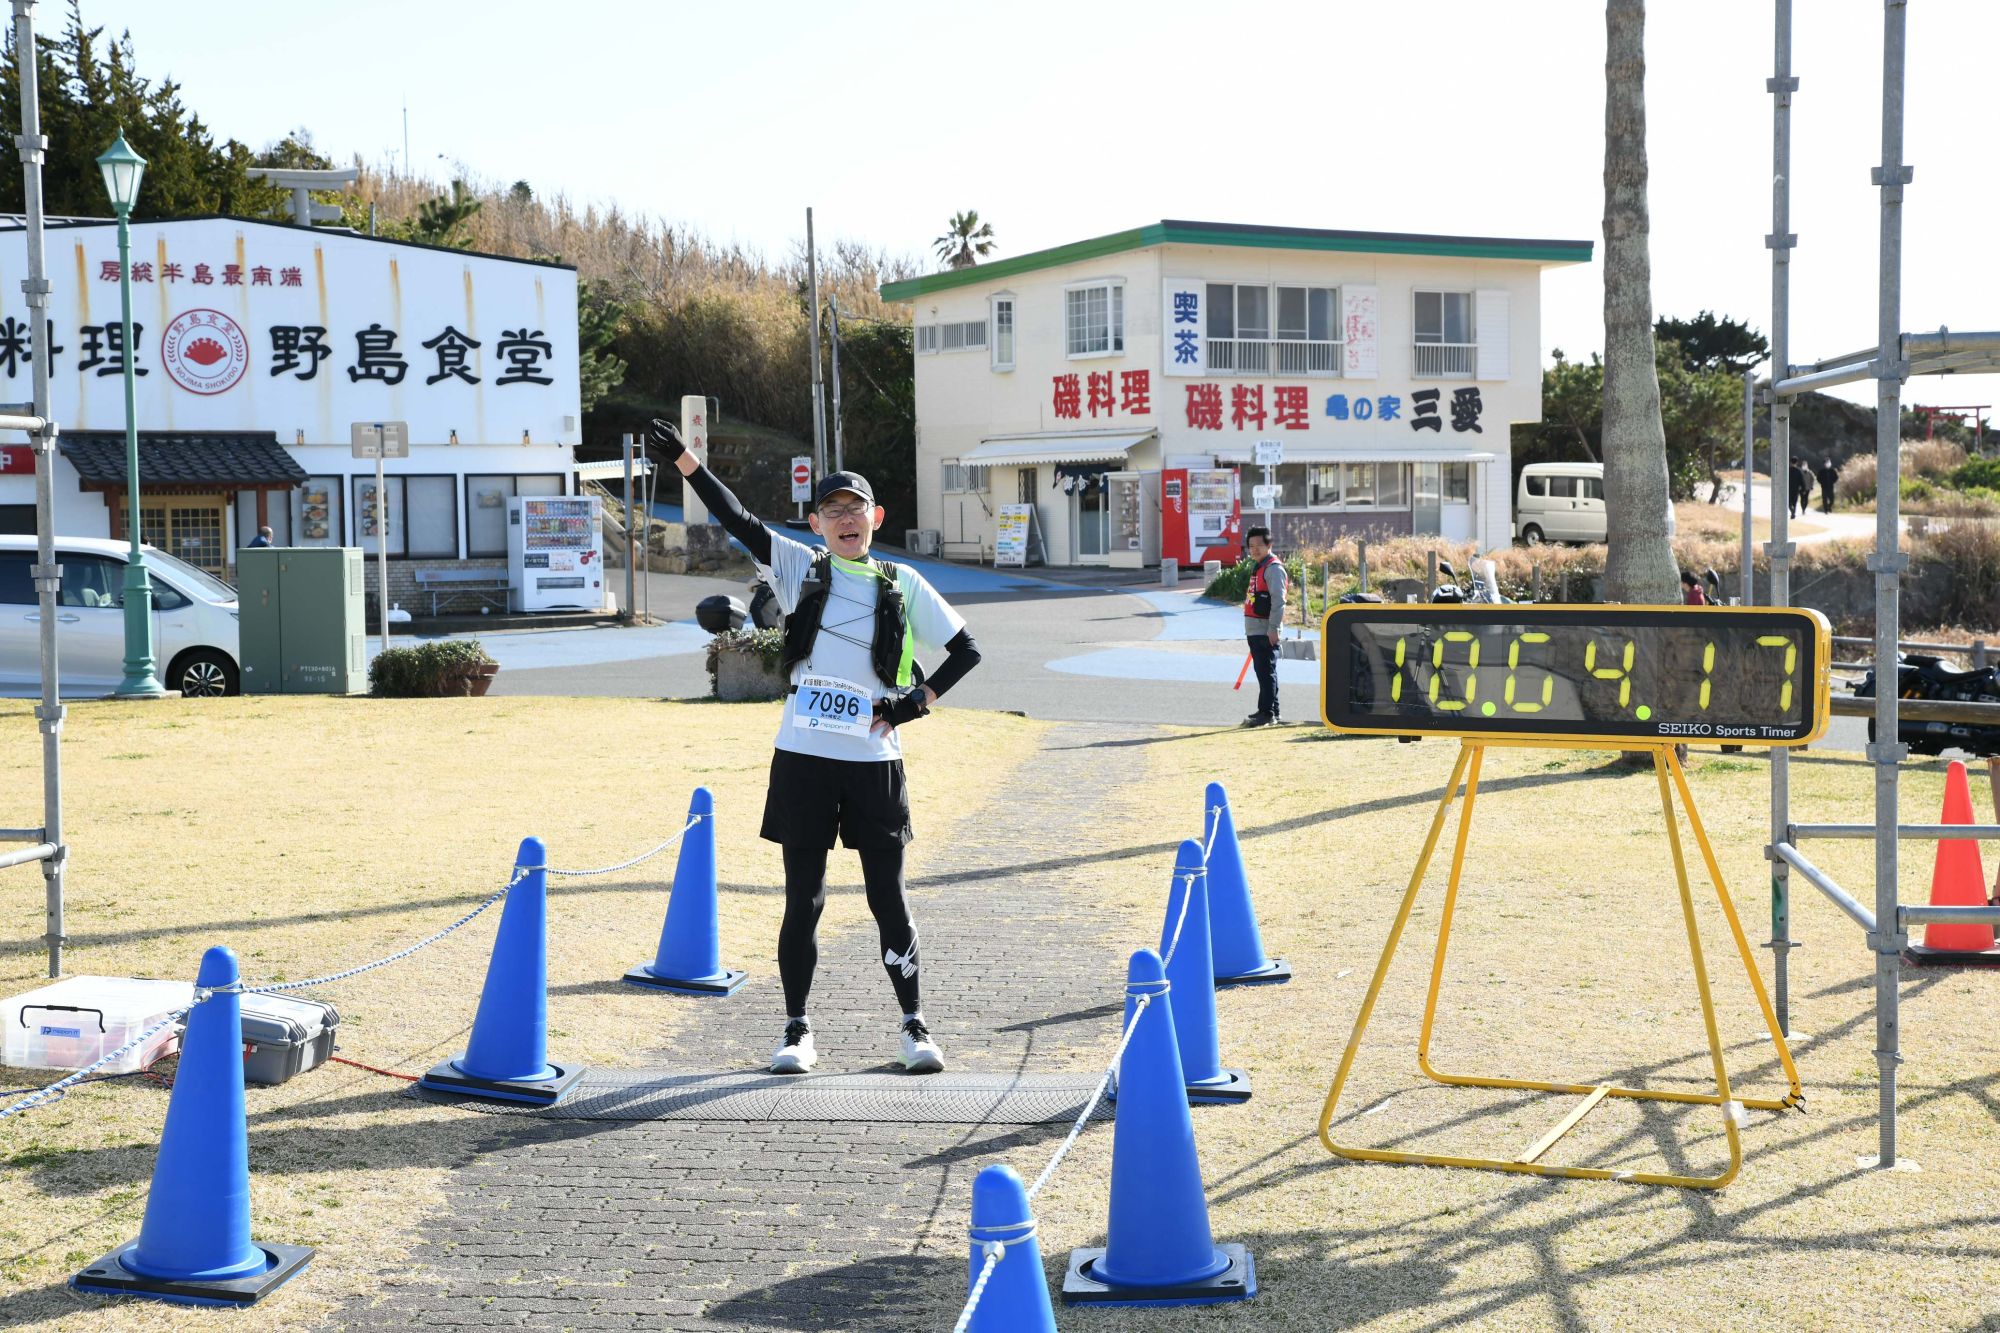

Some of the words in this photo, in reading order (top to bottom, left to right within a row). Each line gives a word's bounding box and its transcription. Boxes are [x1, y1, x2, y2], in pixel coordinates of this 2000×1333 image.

[100, 261, 302, 287] 房総半島最南端
[1174, 290, 1198, 364] 喫茶
[269, 323, 554, 386] 野島食堂
[1052, 369, 1151, 419] 磯料理
[1185, 383, 1310, 431] 磯料理
[808, 691, 860, 716] 7096
[820, 722, 844, 731] nippon
[1658, 722, 1712, 735] SEIKO
[1715, 725, 1757, 737] Sports
[1760, 726, 1796, 737] Timer
